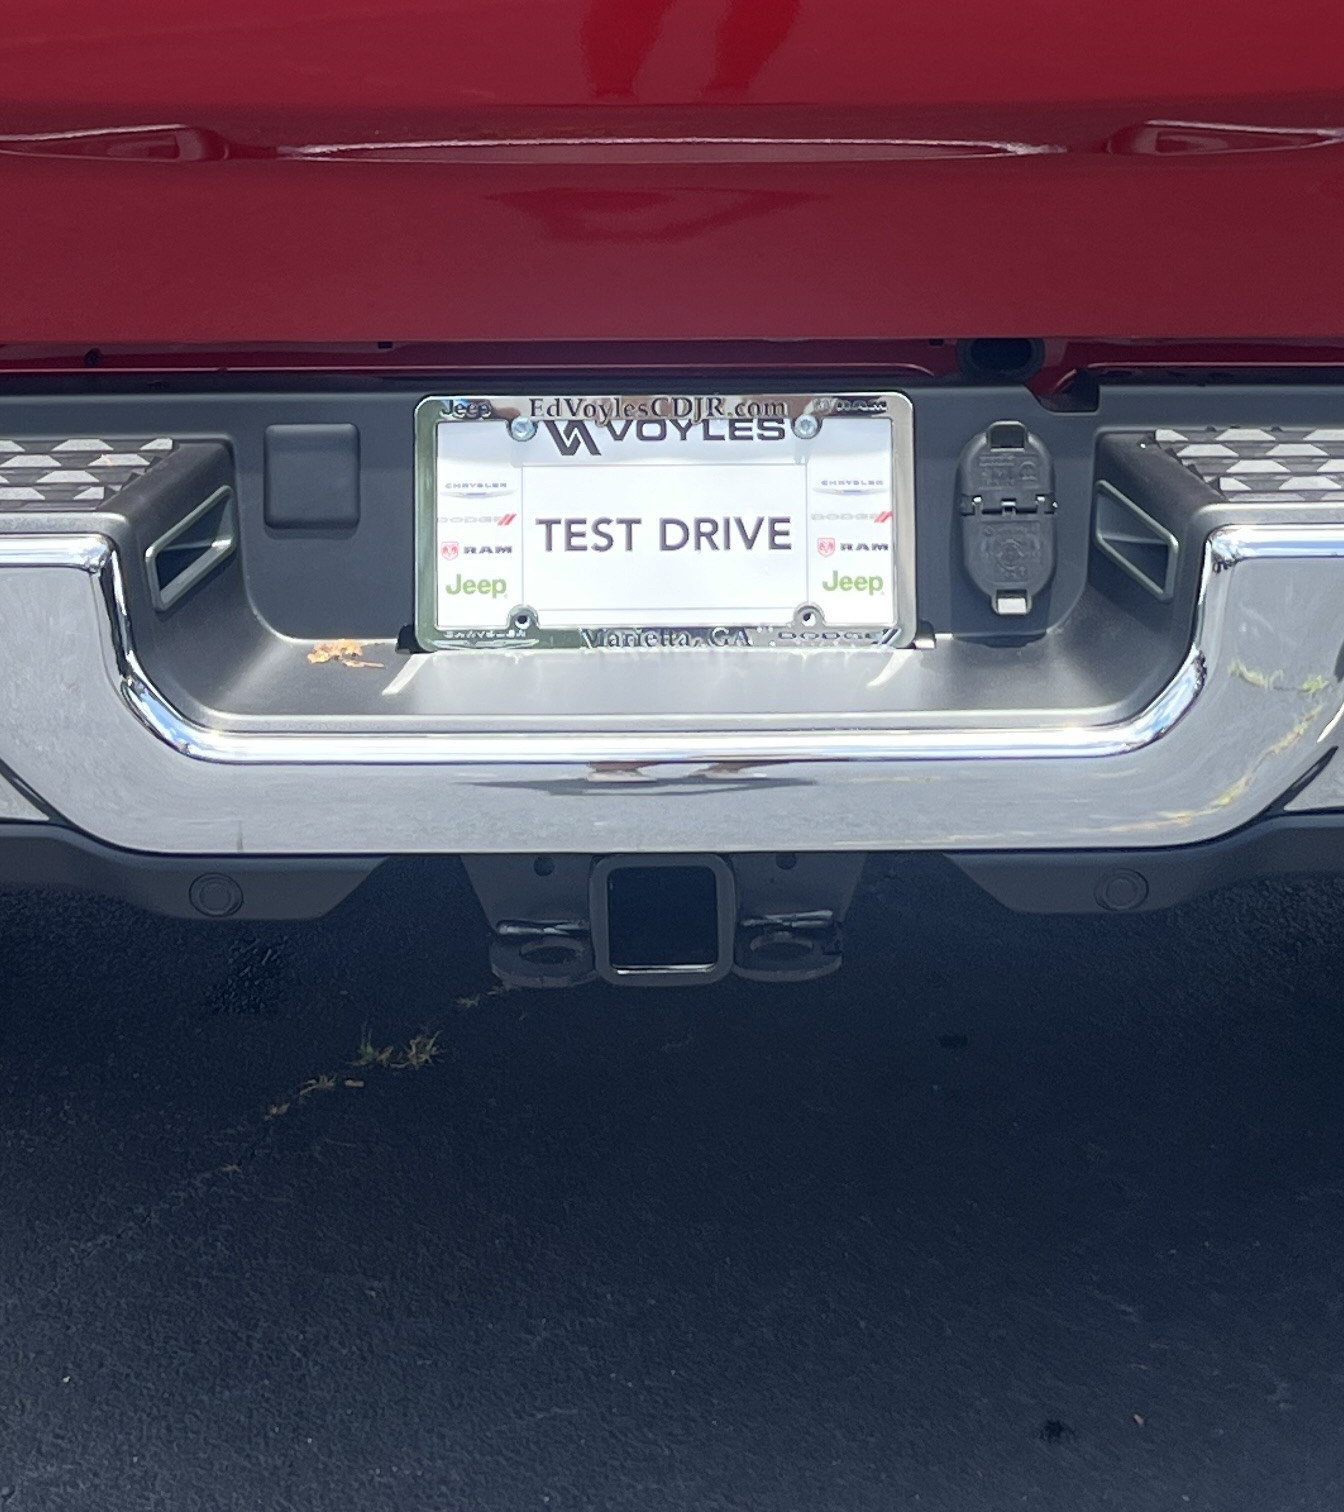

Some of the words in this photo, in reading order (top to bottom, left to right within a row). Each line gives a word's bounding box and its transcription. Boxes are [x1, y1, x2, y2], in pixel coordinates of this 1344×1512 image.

[440, 399, 493, 419] Jeep
[529, 396, 788, 426] EdVoylesCDJR.com
[605, 419, 786, 442] VOYLES
[535, 517, 643, 552] TEST
[659, 516, 792, 551] DRIVE
[463, 545, 513, 554] RAM
[839, 542, 889, 551] RAM
[445, 573, 507, 599] Jeep
[822, 570, 884, 596] Jeep
[709, 626, 755, 648] GA
